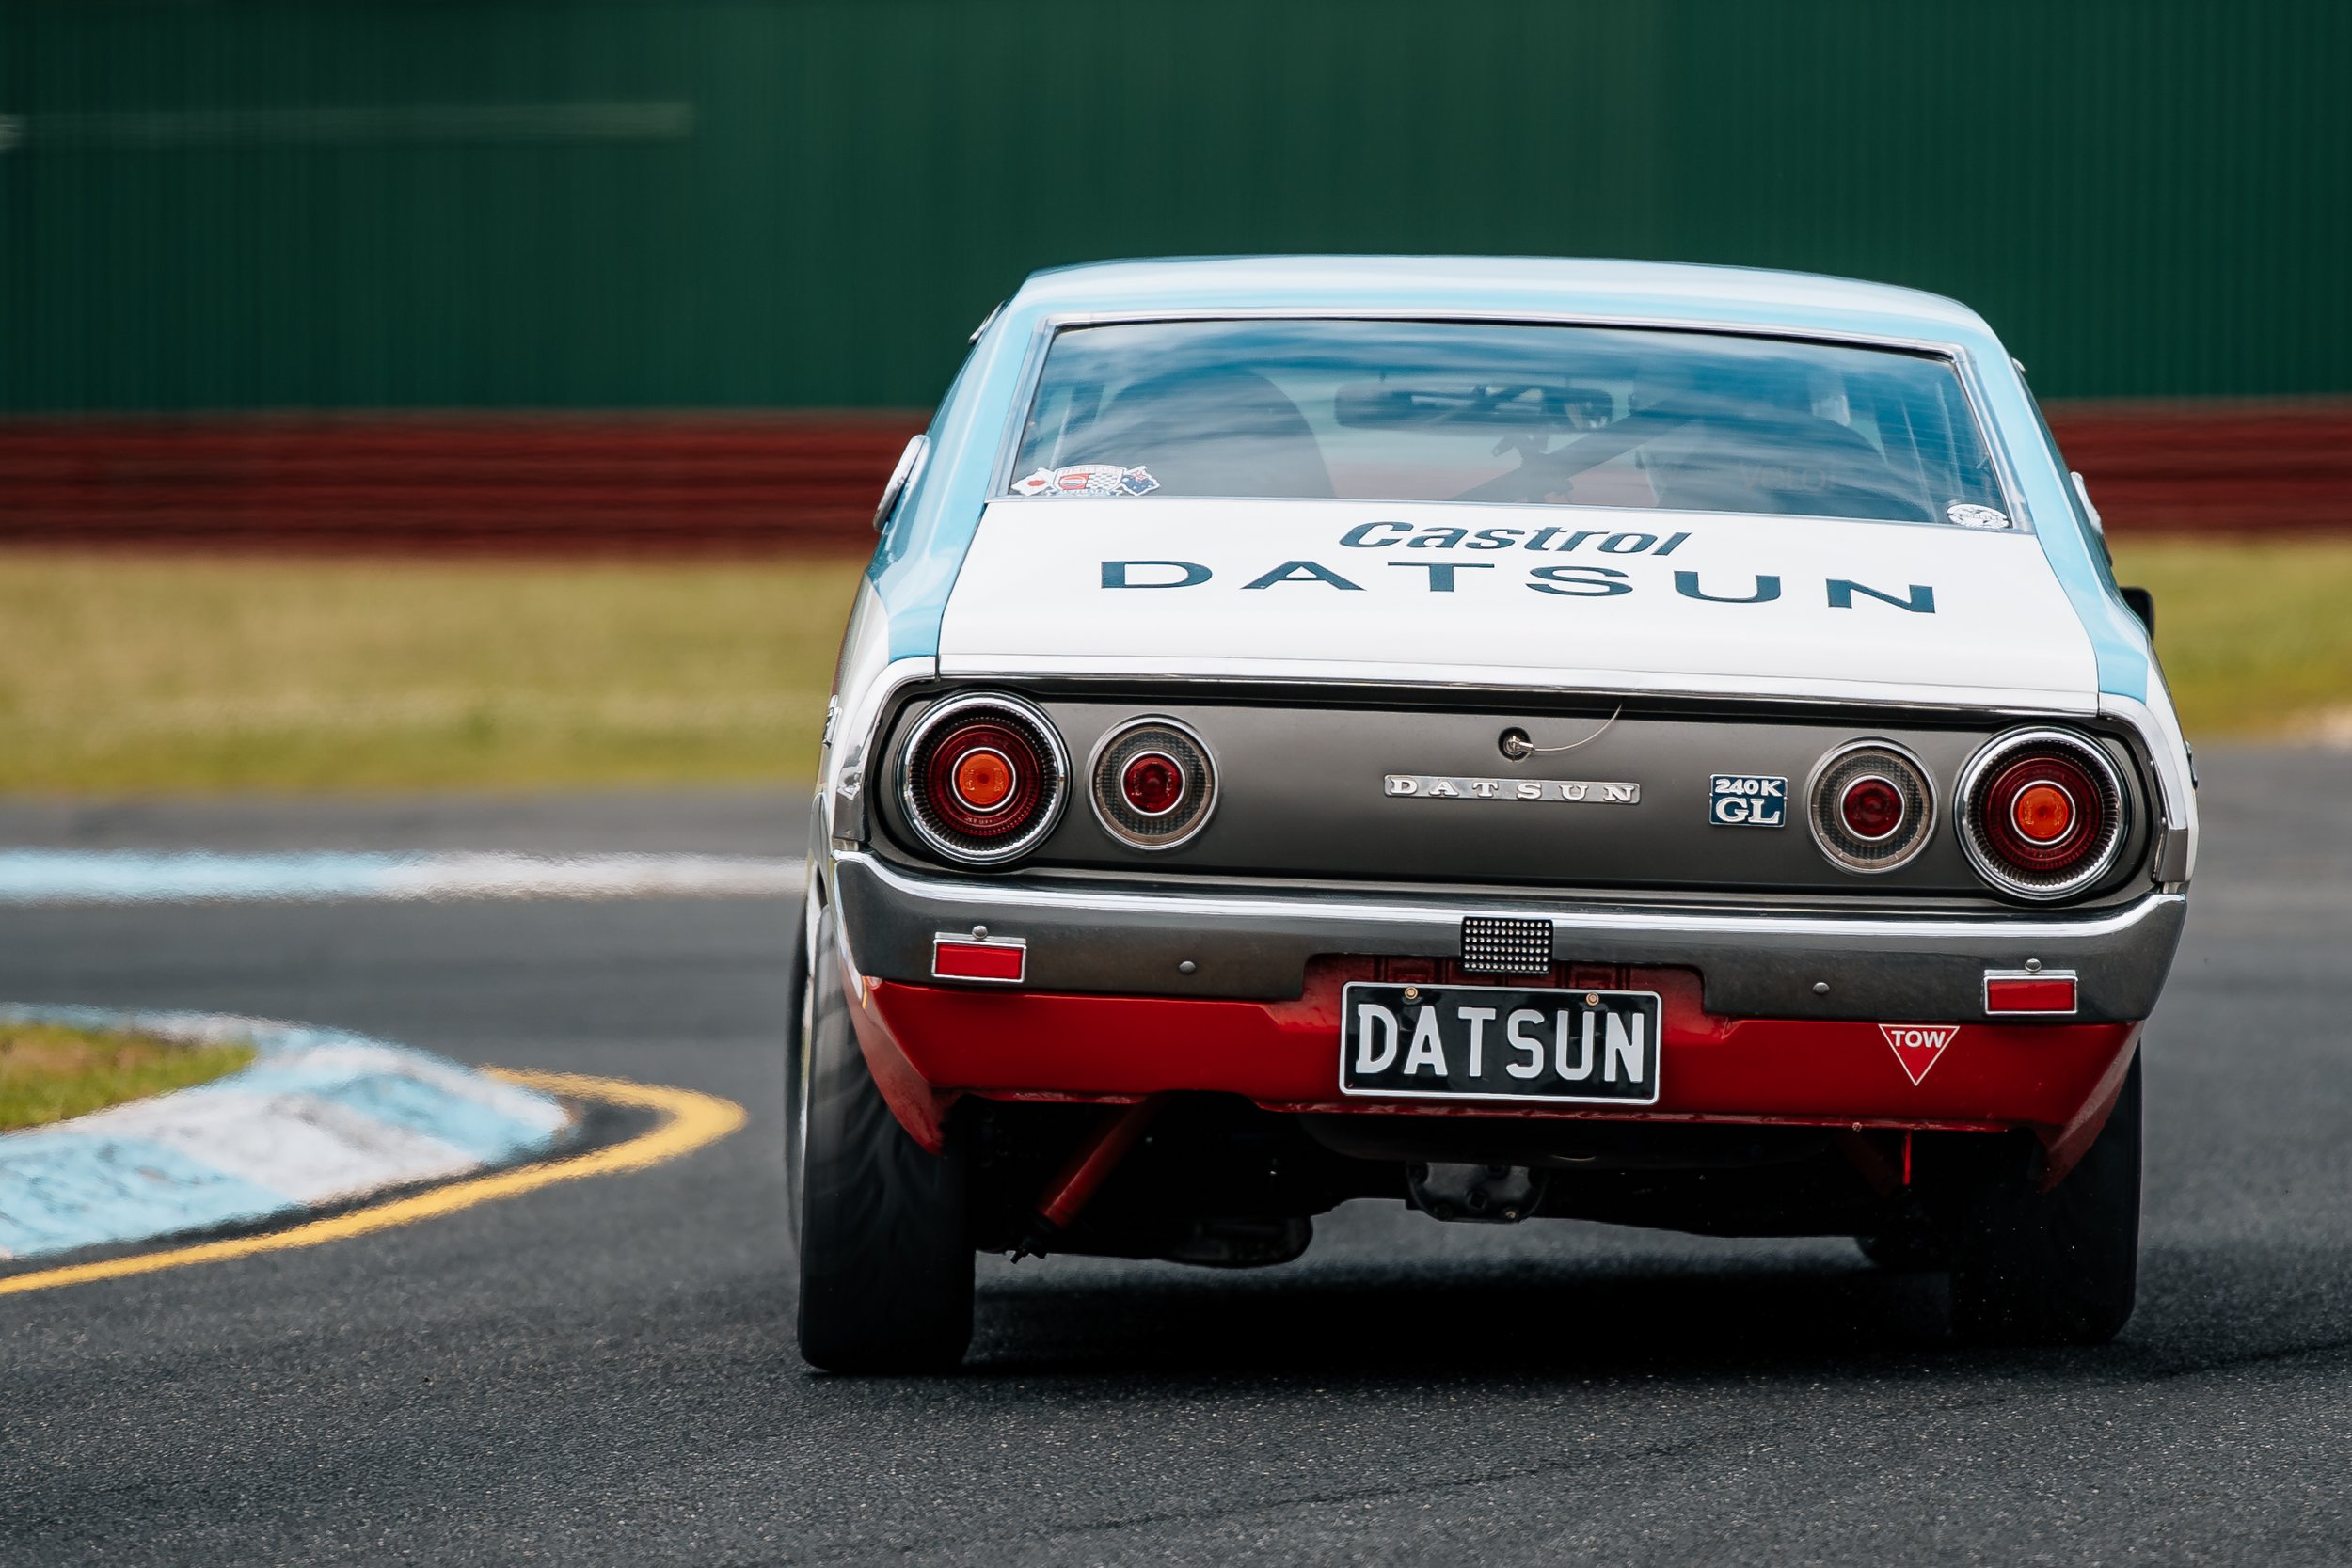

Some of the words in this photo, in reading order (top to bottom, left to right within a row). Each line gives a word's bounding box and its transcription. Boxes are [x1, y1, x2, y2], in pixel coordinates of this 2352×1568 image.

[1339, 521, 1692, 557] Castrol
[1101, 560, 1936, 614] DATSUN
[1389, 777, 1635, 802] DATSUN
[1714, 778, 1782, 797] 240K
[1715, 797, 1780, 824] GL
[1355, 1003, 1645, 1083] DATSUN
[1890, 1030, 1947, 1048] TOW
